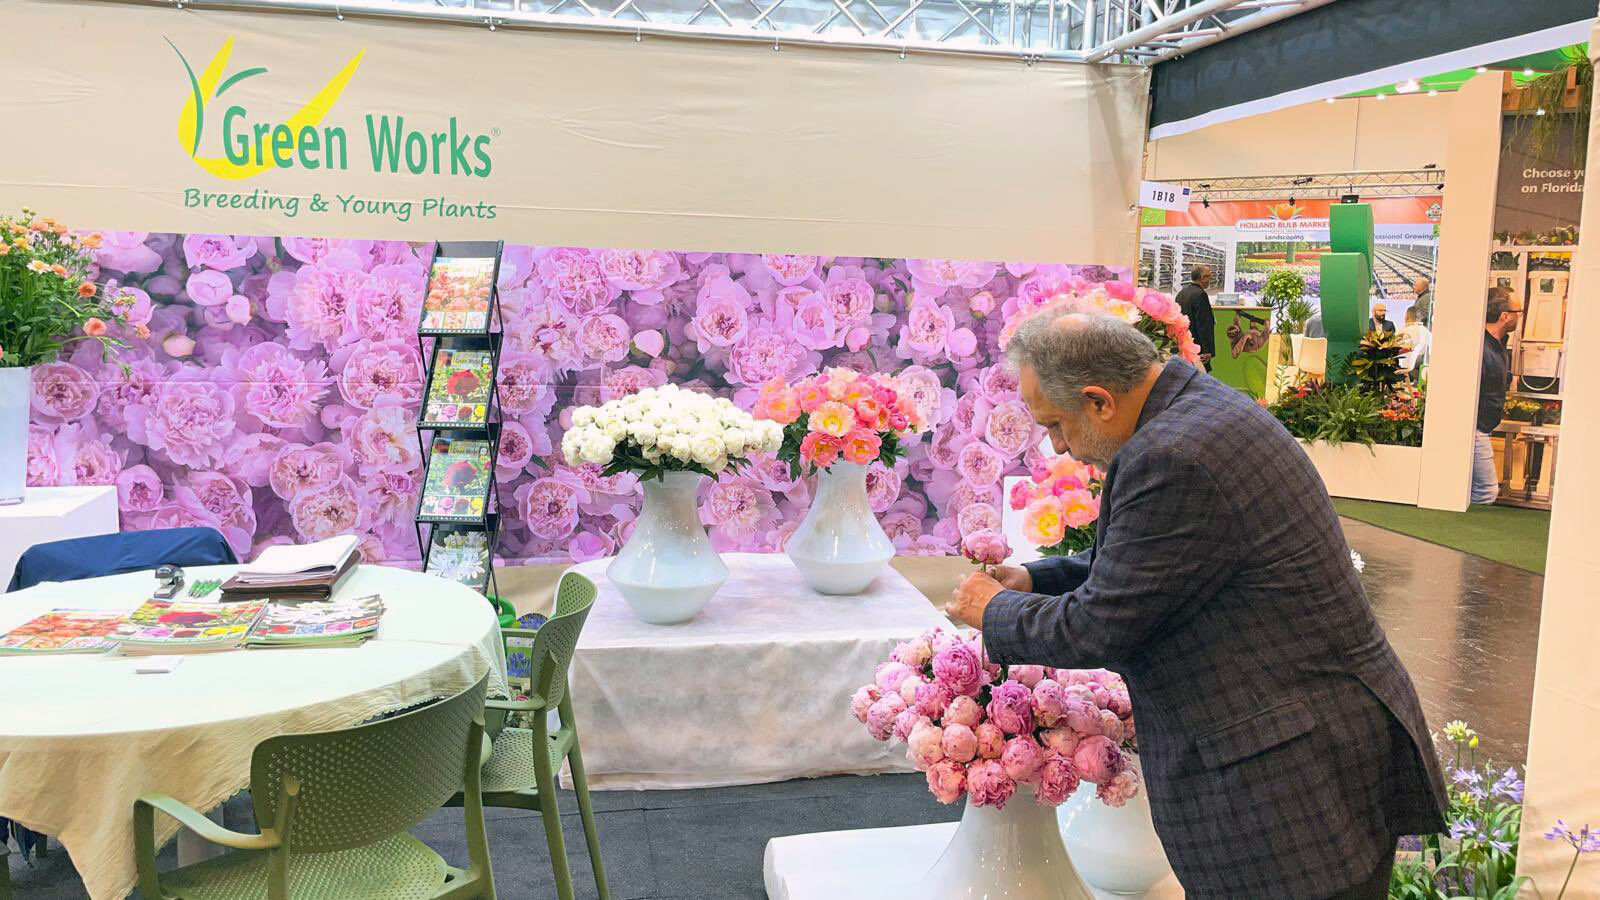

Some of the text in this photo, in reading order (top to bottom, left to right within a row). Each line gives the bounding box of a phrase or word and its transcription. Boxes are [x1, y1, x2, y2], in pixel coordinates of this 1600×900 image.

[223, 105, 348, 170] Green
[1522, 168, 1571, 178] Choose
[1521, 182, 1584, 193] on Florida
[1152, 190, 1175, 203] 1B18
[184, 188, 497, 222] Breeding & Young Plants
[1404, 232, 1434, 240] Growing
